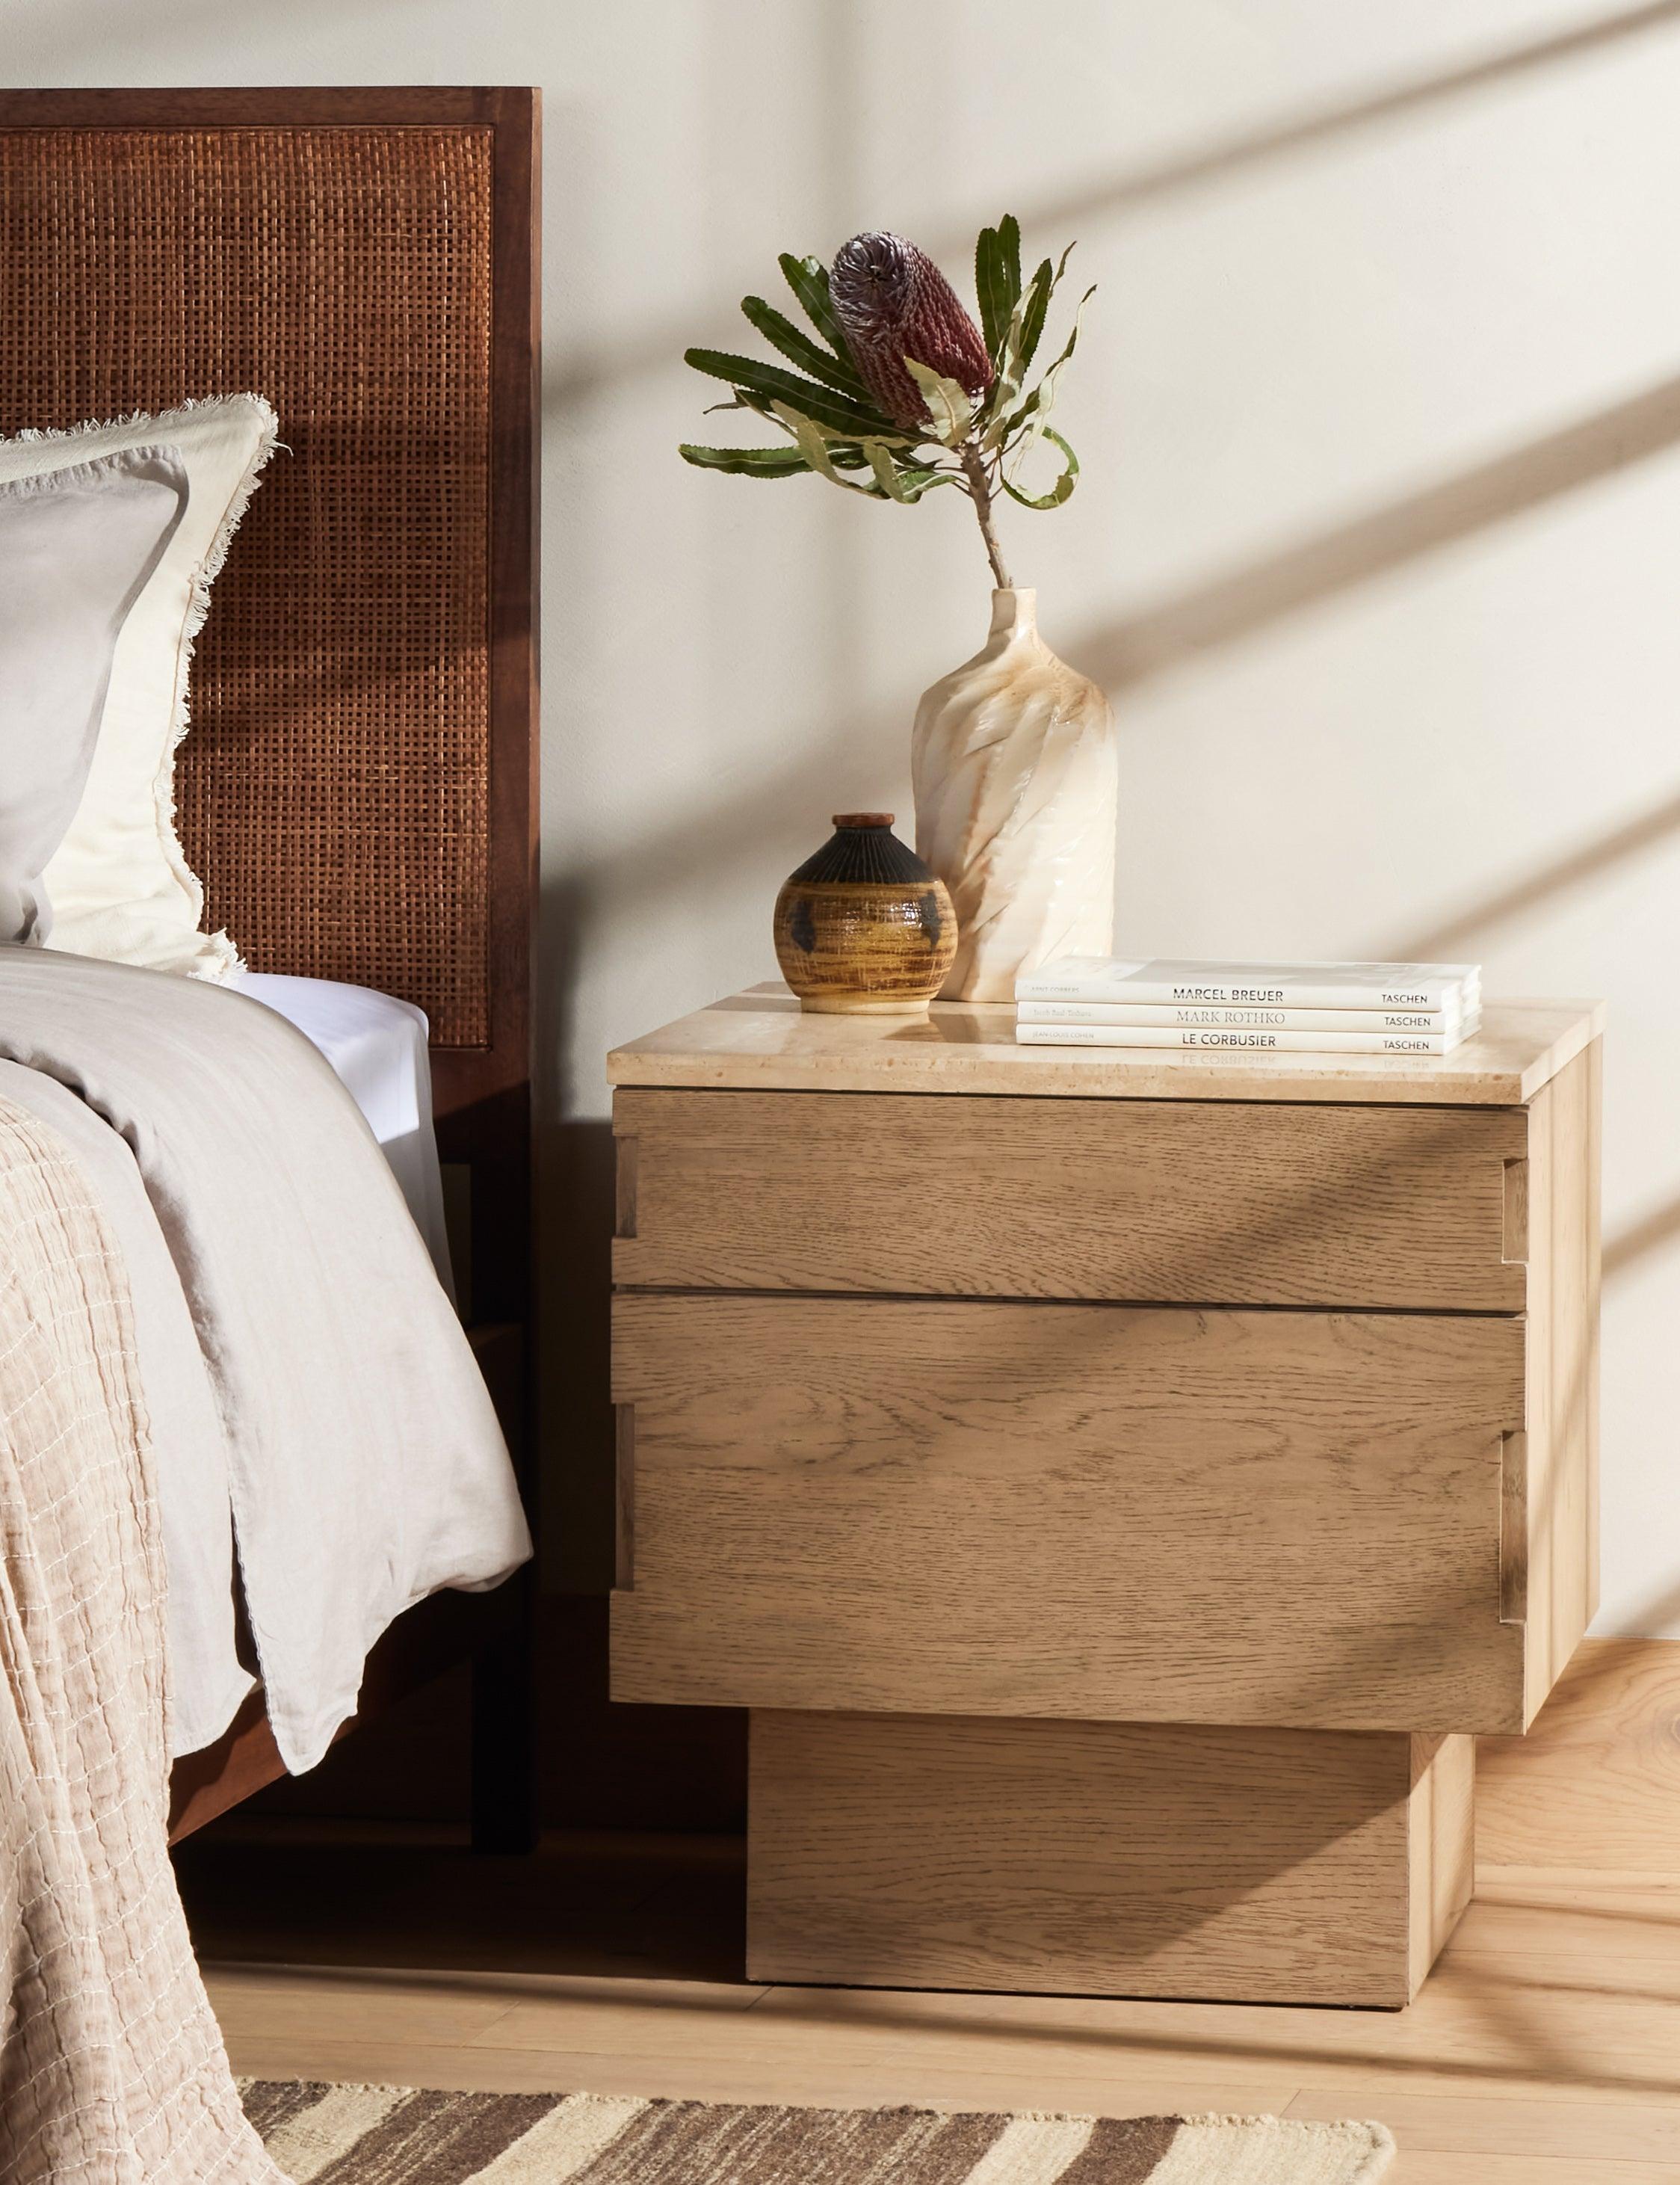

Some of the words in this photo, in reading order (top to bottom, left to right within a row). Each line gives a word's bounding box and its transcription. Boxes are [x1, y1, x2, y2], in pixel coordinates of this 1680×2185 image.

[1173, 988, 1227, 1000] MARCEL
[1232, 990, 1283, 1002] BREUER
[1381, 993, 1427, 1004] TASCHEN
[1176, 1011, 1220, 1023] MARK
[1224, 1011, 1285, 1024] ROTHKO
[1384, 1017, 1430, 1026] TASCHEN
[1182, 1033, 1196, 1044] LE
[1200, 1034, 1276, 1047] CORBUSIER
[1383, 1040, 1430, 1050] TASCHEN
